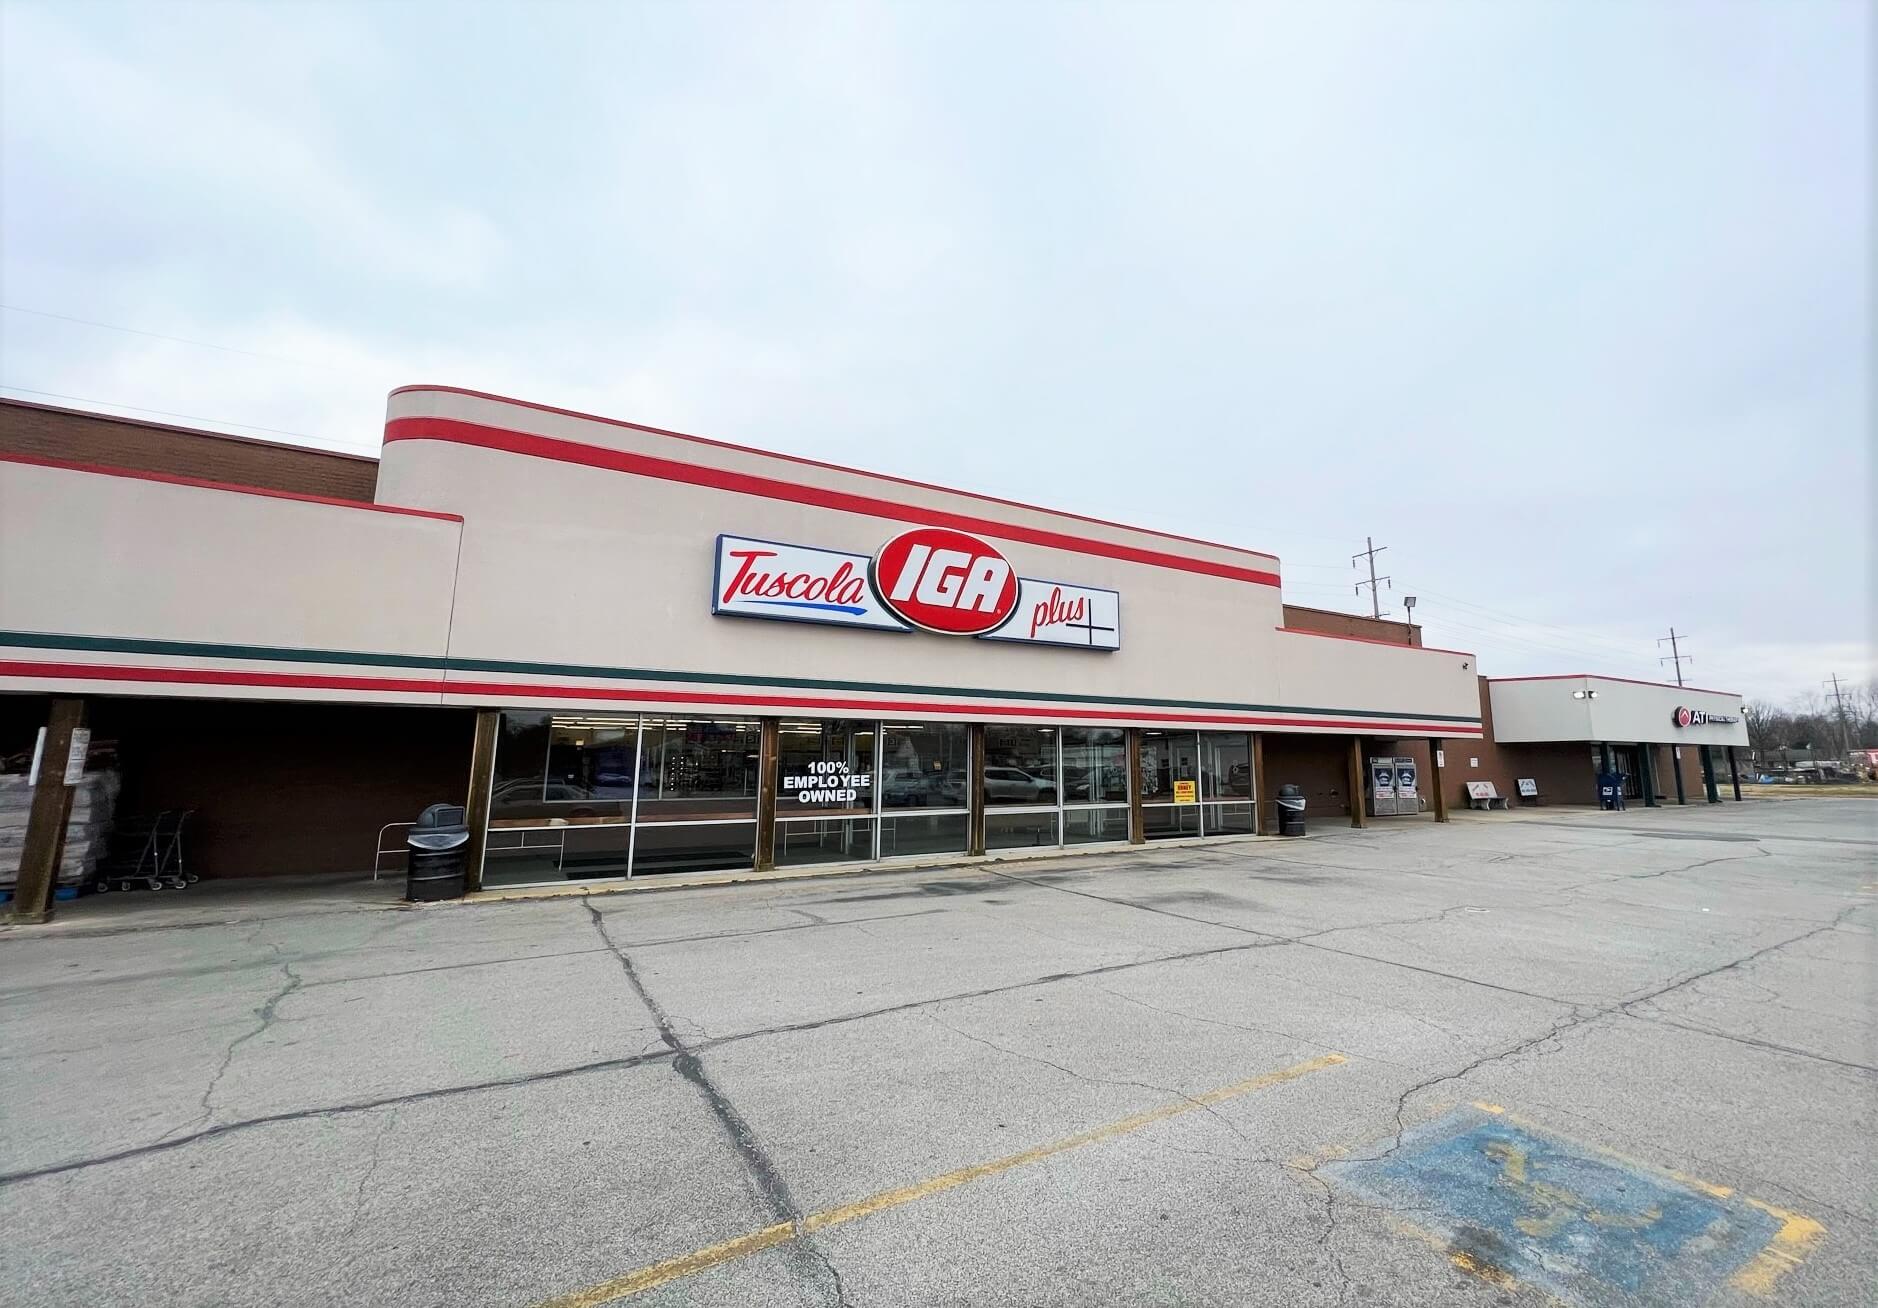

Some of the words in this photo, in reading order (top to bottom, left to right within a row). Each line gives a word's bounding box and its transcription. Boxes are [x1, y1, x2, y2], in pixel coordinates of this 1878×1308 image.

[723, 551, 864, 604] Tuscola
[890, 544, 1010, 613] IGA
[1030, 587, 1085, 638] plus
[1692, 711, 1708, 724] ATI
[807, 761, 850, 774] 100%
[783, 775, 871, 789] EMPLOYEE
[798, 789, 857, 803] OWNED
